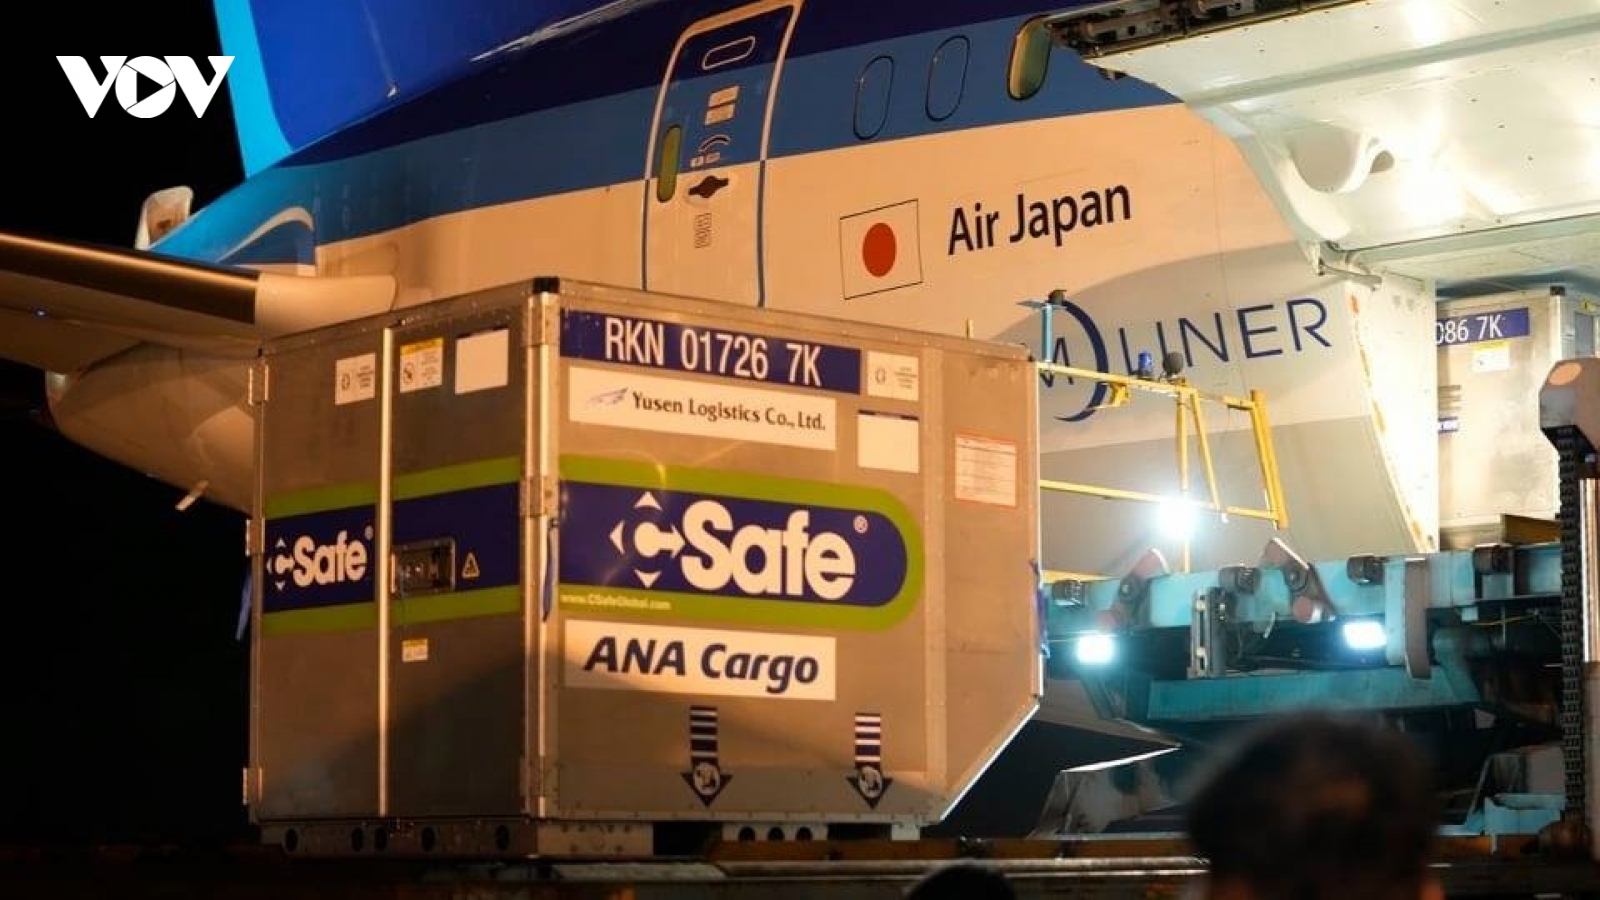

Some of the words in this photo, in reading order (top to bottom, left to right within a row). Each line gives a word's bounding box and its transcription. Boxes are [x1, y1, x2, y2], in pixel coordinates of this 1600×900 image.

[948, 203, 999, 255] Air
[1009, 184, 1131, 247] Japan
[605, 317, 665, 366] RKN
[681, 329, 769, 380] 01726
[786, 343, 823, 387] 7K
[1477, 314, 1504, 340] 7K
[632, 391, 683, 414] Yusen
[689, 398, 761, 422] Logistics
[797, 411, 826, 431] Ltd.
[583, 636, 687, 677] ANA
[701, 643, 819, 695] Cargo
